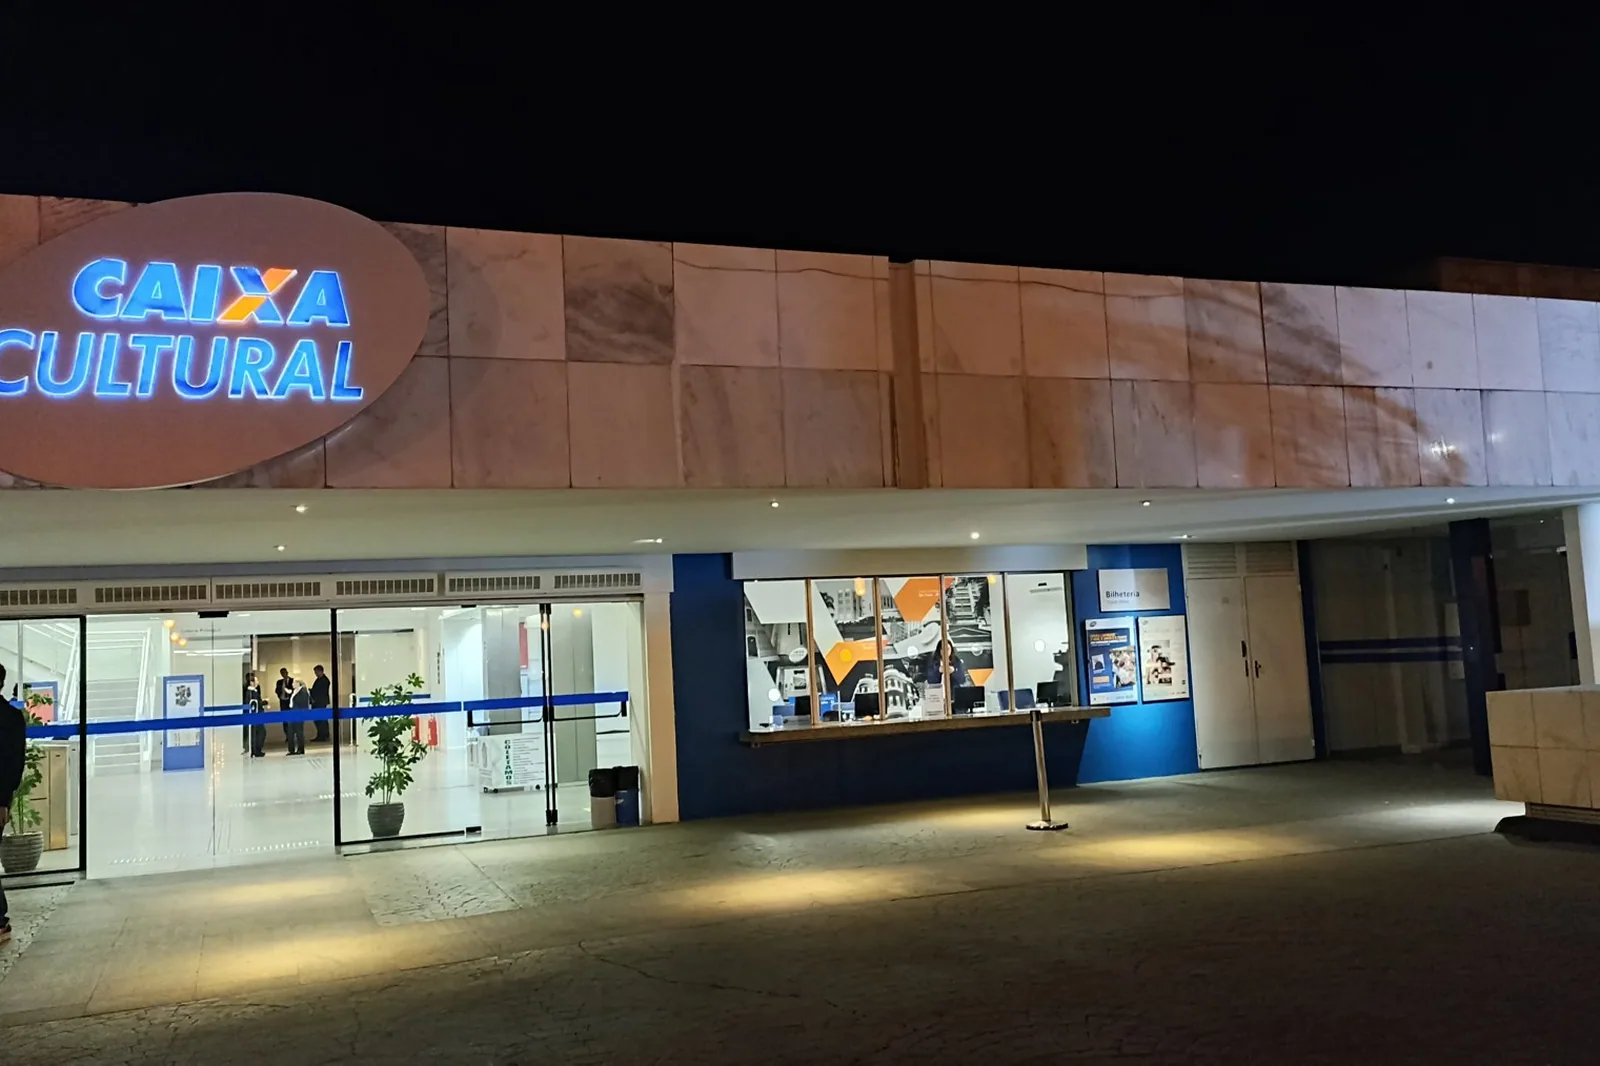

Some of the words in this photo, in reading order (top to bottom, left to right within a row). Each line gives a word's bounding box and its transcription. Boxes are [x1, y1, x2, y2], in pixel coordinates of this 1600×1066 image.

[72, 258, 350, 326] CAIXA
[0, 328, 364, 400] CULTURAL
[1105, 590, 1140, 598] Bilheteria
